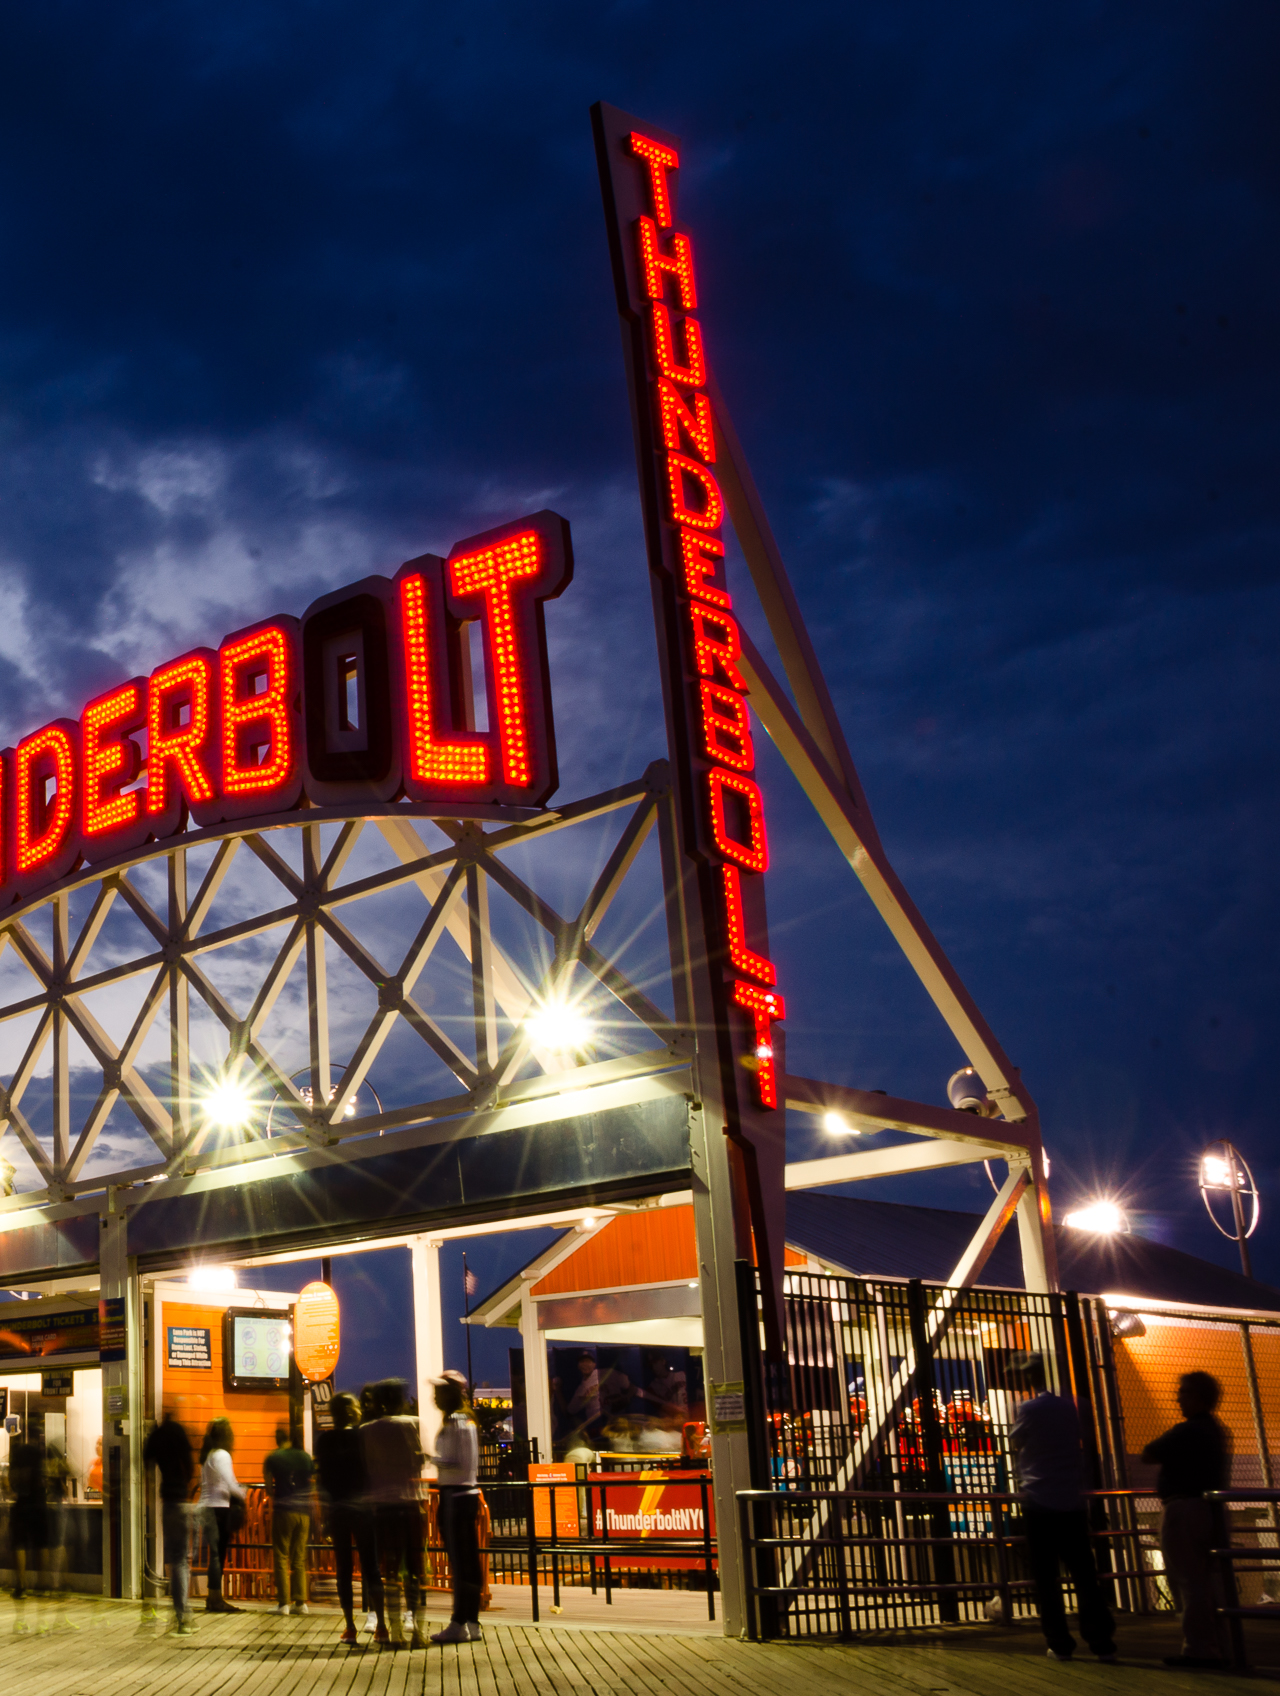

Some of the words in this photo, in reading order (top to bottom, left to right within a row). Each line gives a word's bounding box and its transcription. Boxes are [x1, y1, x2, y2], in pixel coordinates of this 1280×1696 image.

[629, 131, 785, 1111] THUNDERBOLT
[53, 1313, 85, 1326] TICKETS
[311, 1383, 331, 1402] 10
